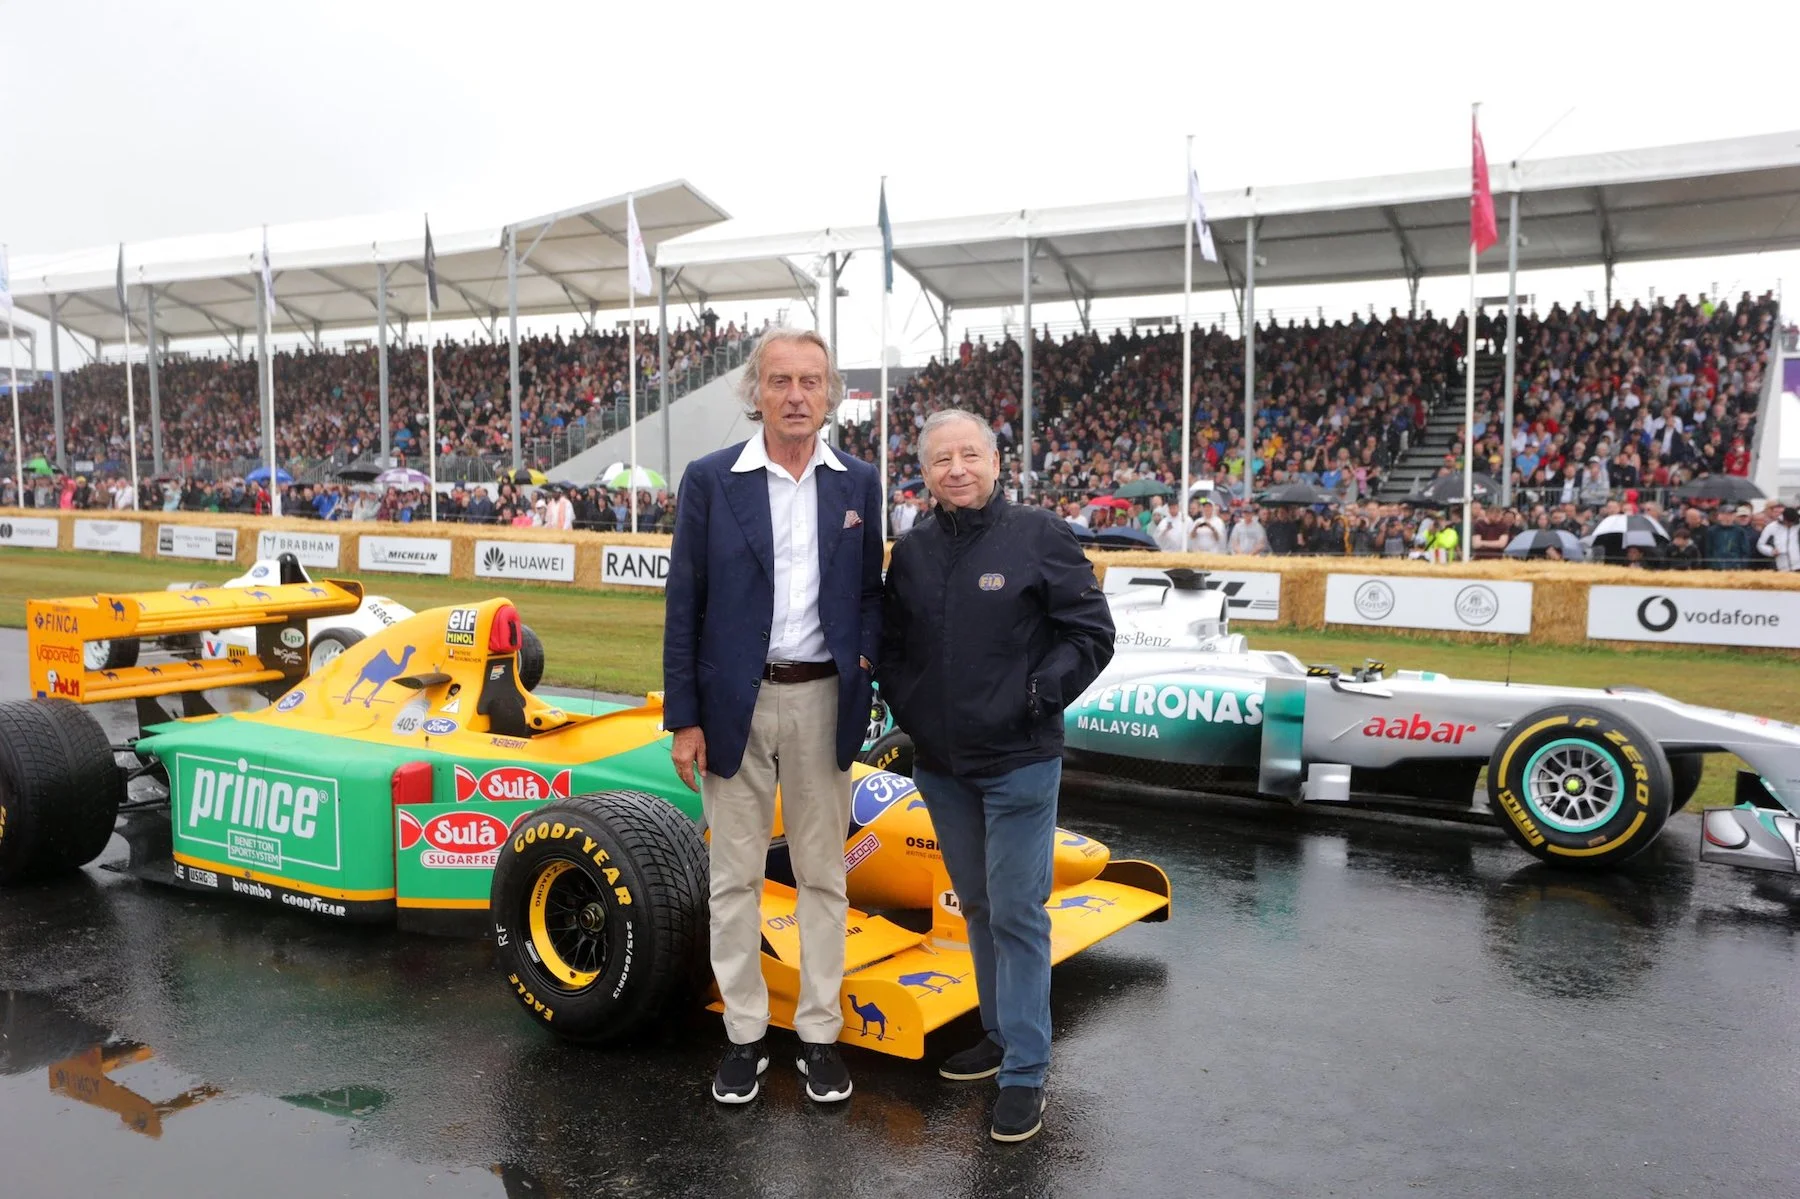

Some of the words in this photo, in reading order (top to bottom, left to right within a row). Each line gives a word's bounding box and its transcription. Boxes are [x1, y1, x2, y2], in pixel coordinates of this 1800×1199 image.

[279, 539, 334, 553] BRABHAM
[388, 550, 438, 561] MICHELIN
[508, 555, 565, 571] HUAWEI
[981, 576, 1003, 588] FIA
[45, 613, 78, 634] FINCA
[449, 609, 477, 631] elf
[1684, 609, 1780, 627] vodafone
[446, 632, 474, 645] MINOL
[1081, 683, 1264, 726] PETRONAS
[426, 719, 452, 732] Ford
[1077, 715, 1160, 739] MALAYSIA
[1363, 713, 1476, 745] aabar
[1574, 718, 1600, 729] P
[1603, 729, 1650, 807] ZERO
[1497, 789, 1545, 847] PIRELLI
[230, 845, 279, 864] SPORTSYSTEM
[234, 835, 275, 852] BENETTON
[232, 877, 272, 900] brembo
[535, 872, 551, 907] RACING
[281, 893, 347, 917] GOODYEAR
[495, 923, 509, 947] RF
[507, 972, 555, 1022] EAGLE
